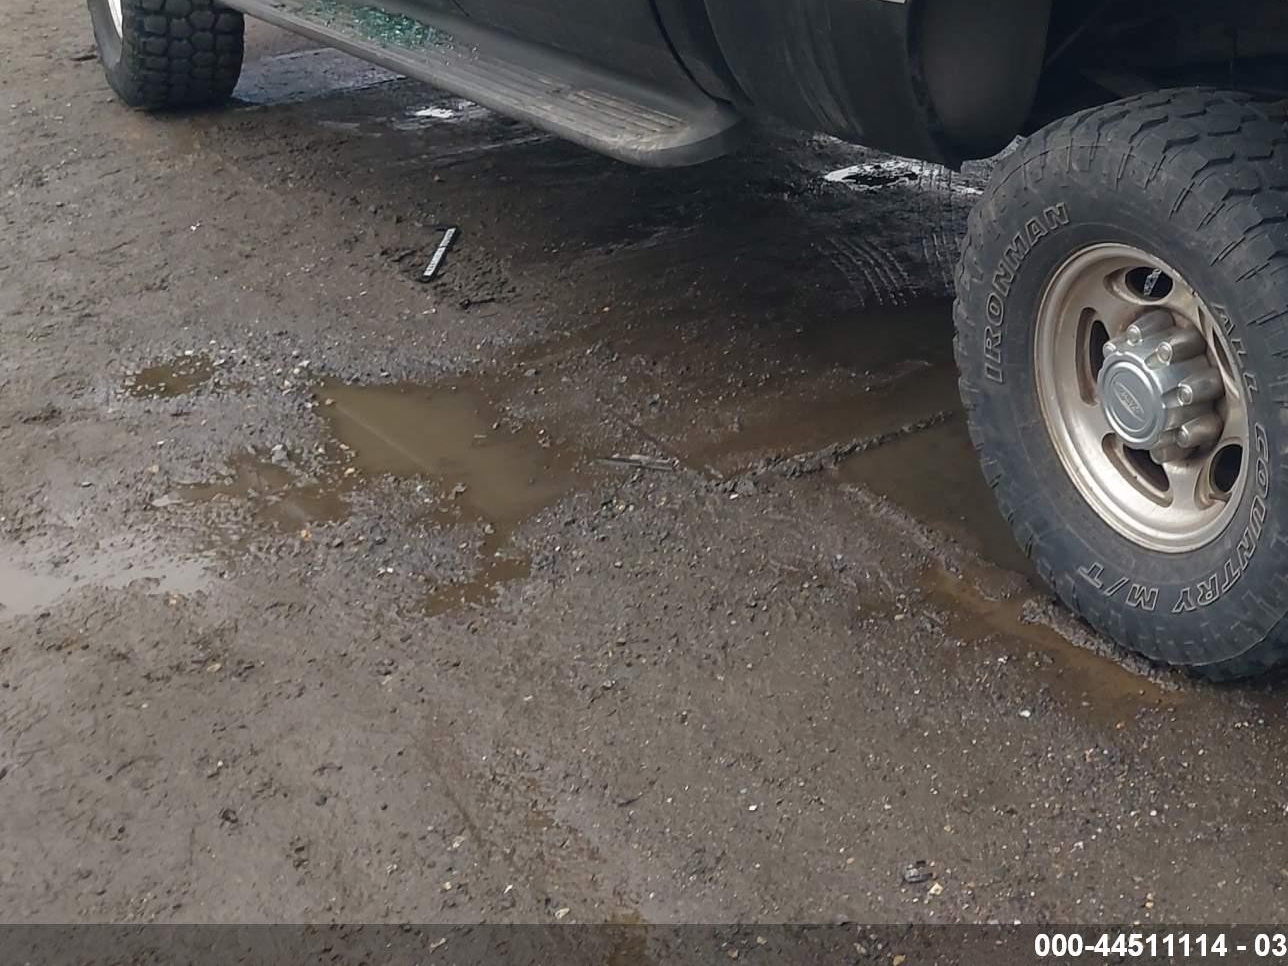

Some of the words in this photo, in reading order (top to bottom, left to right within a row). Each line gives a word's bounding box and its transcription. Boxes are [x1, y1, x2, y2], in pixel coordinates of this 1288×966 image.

[983, 202, 1071, 383] IRONMAN
[1078, 561, 1159, 611] M/T
[1172, 422, 1270, 613] COUNTRY
